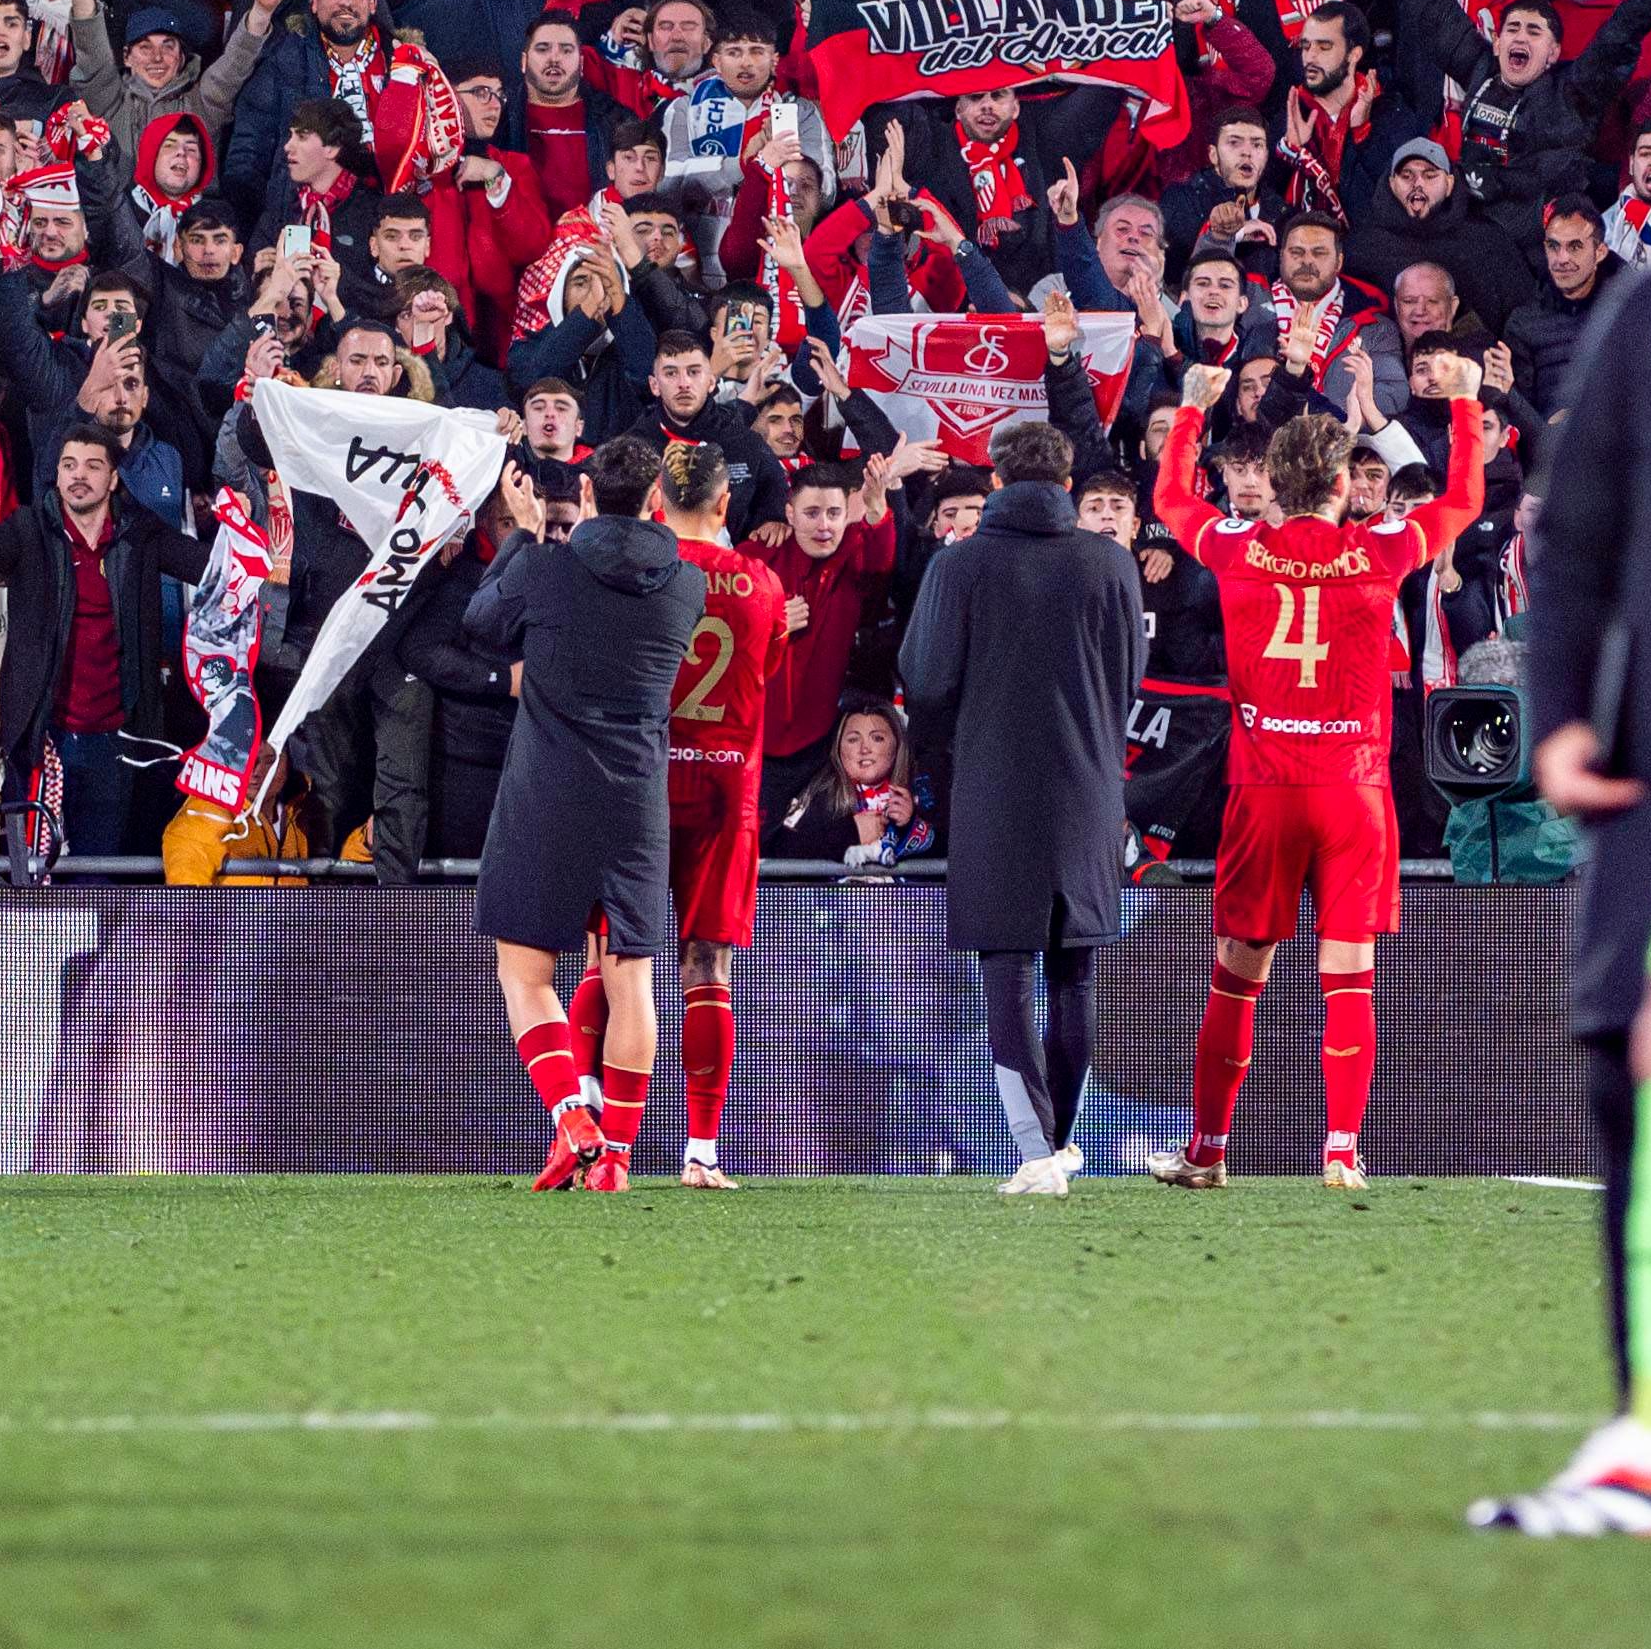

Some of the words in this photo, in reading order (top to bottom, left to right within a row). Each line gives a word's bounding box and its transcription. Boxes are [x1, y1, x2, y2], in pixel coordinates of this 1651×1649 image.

[920, 31, 988, 77] del
[992, 20, 1172, 72] Ariscal
[910, 378, 957, 397] SEVILLA
[956, 382, 987, 398] UNA
[988, 386, 1016, 401] VEZ
[1017, 387, 1048, 403] MAS
[1246, 539, 1307, 578] SERGIO
[1310, 544, 1371, 576] RAMOS
[1261, 584, 1331, 689] 4
[674, 616, 735, 722] 2
[177, 755, 242, 808] FANS
